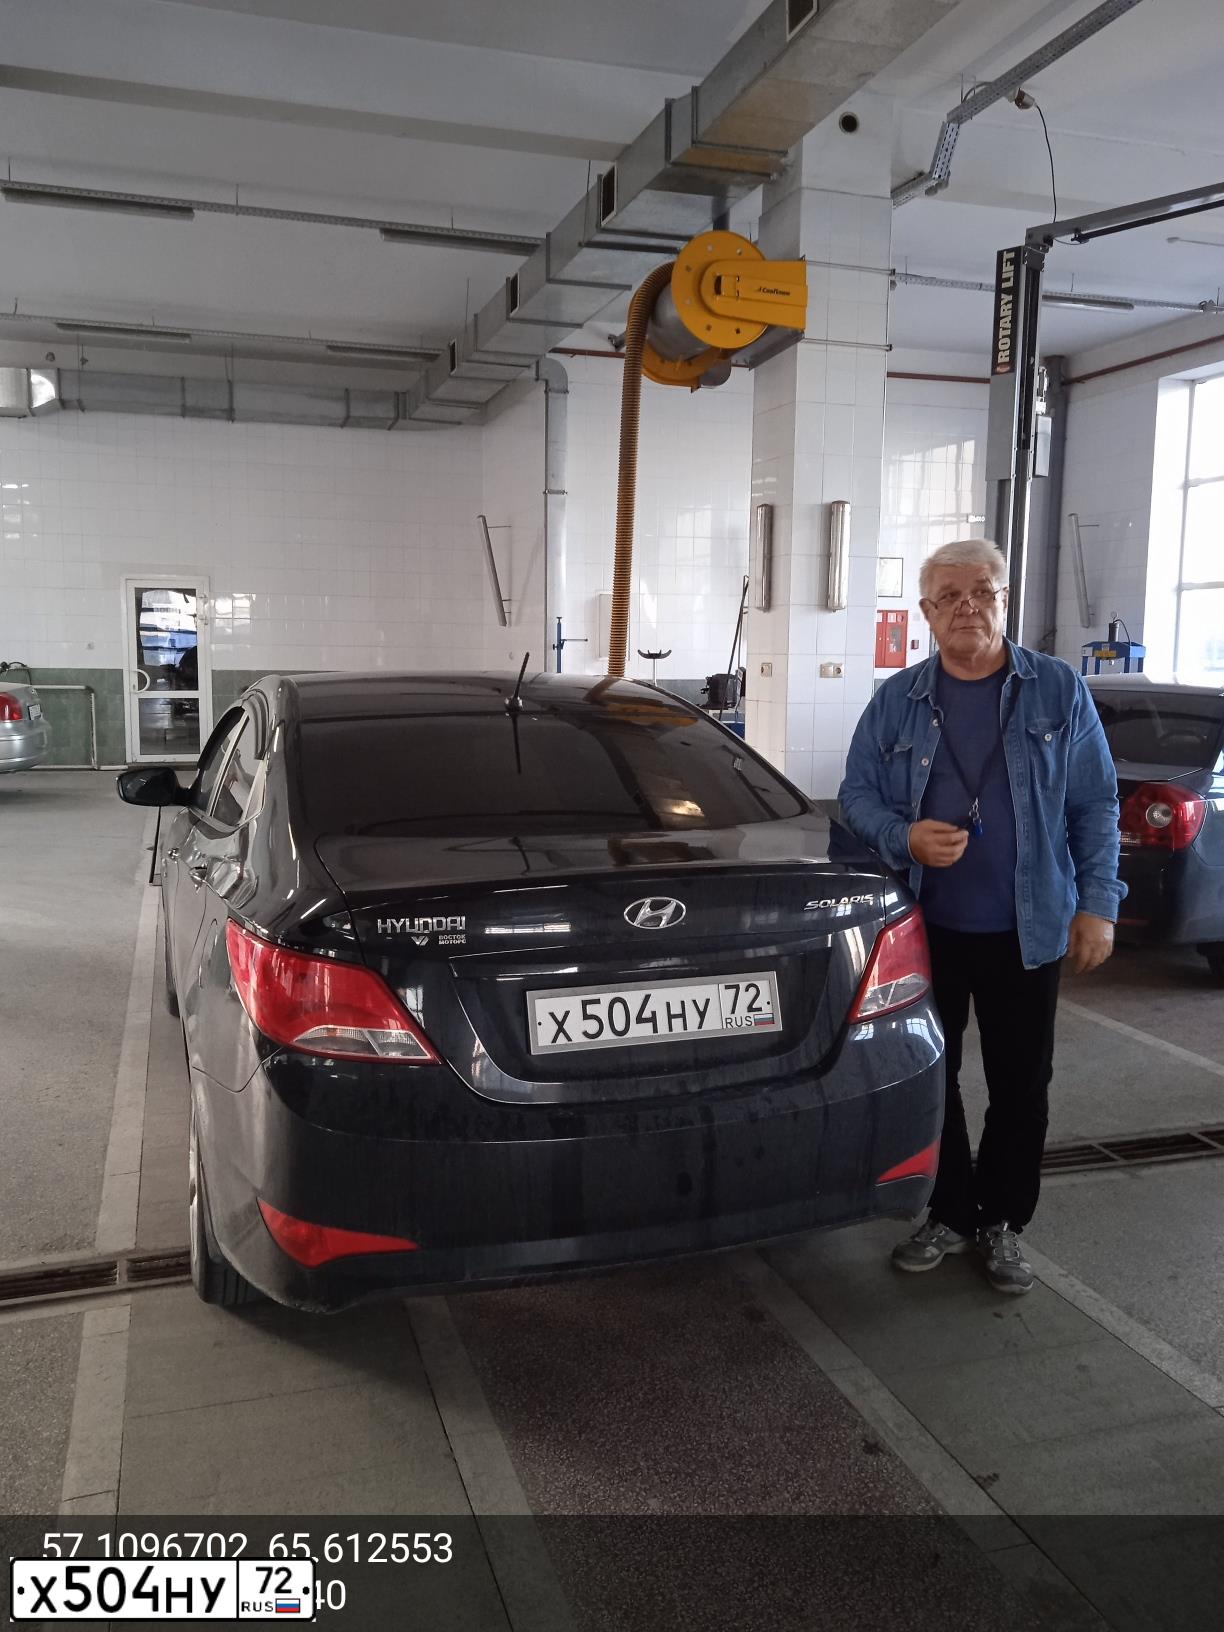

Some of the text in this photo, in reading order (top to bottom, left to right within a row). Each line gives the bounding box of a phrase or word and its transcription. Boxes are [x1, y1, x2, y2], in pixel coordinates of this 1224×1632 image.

[998, 250, 1015, 364] ROTARY LIFT
[804, 893, 874, 911] SOLARIS
[377, 915, 466, 934] HYUNDAI
[724, 982, 762, 1015] 72
[725, 1015, 752, 1029] RUS
